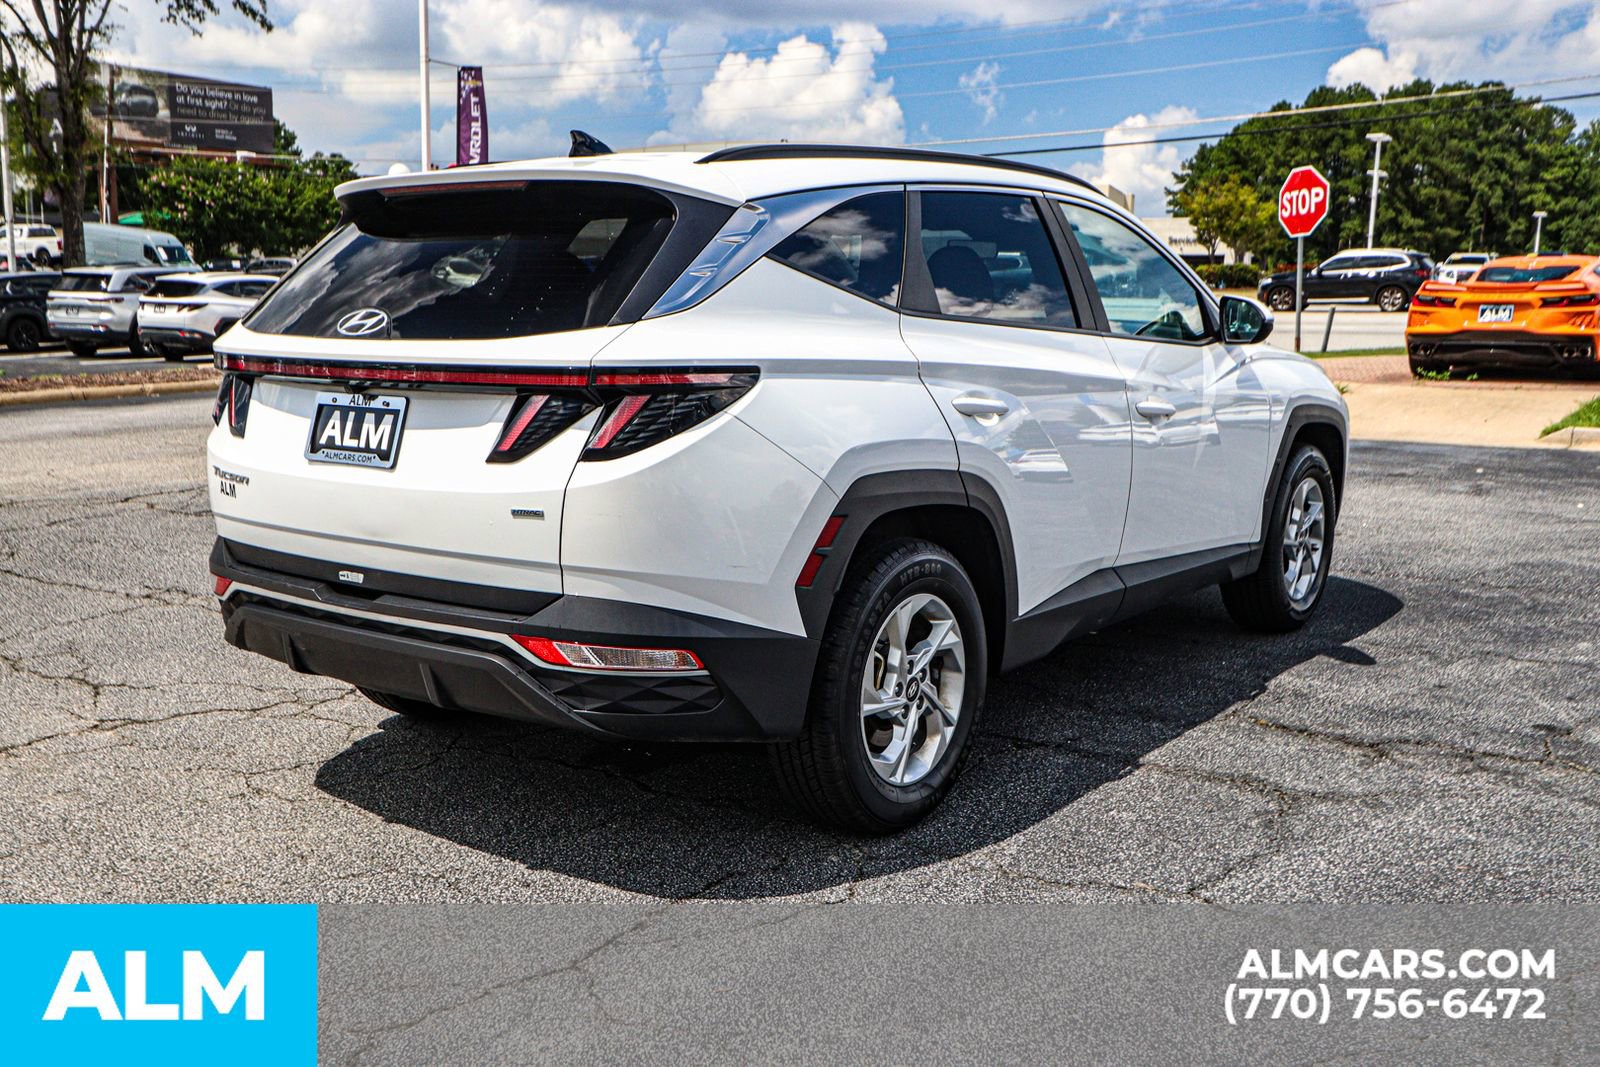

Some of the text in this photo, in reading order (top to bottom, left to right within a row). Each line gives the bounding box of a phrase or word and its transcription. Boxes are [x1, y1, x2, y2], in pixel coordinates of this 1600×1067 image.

[176, 82, 258, 104] Do you believe in love
[176, 95, 185, 104] at
[187, 95, 202, 107] first
[204, 99, 228, 110] sight?
[241, 102, 251, 113] do
[252, 105, 266, 115] you
[198, 109, 207, 118] to
[208, 109, 227, 120] drive
[469, 92, 482, 165] VROLET
[1281, 186, 1325, 218] STOP
[1481, 308, 1511, 321] ALM
[349, 394, 372, 407] ALM
[319, 410, 395, 451] ALM
[324, 451, 373, 463] ALMCARS.COM
[220, 479, 237, 499] ALM
